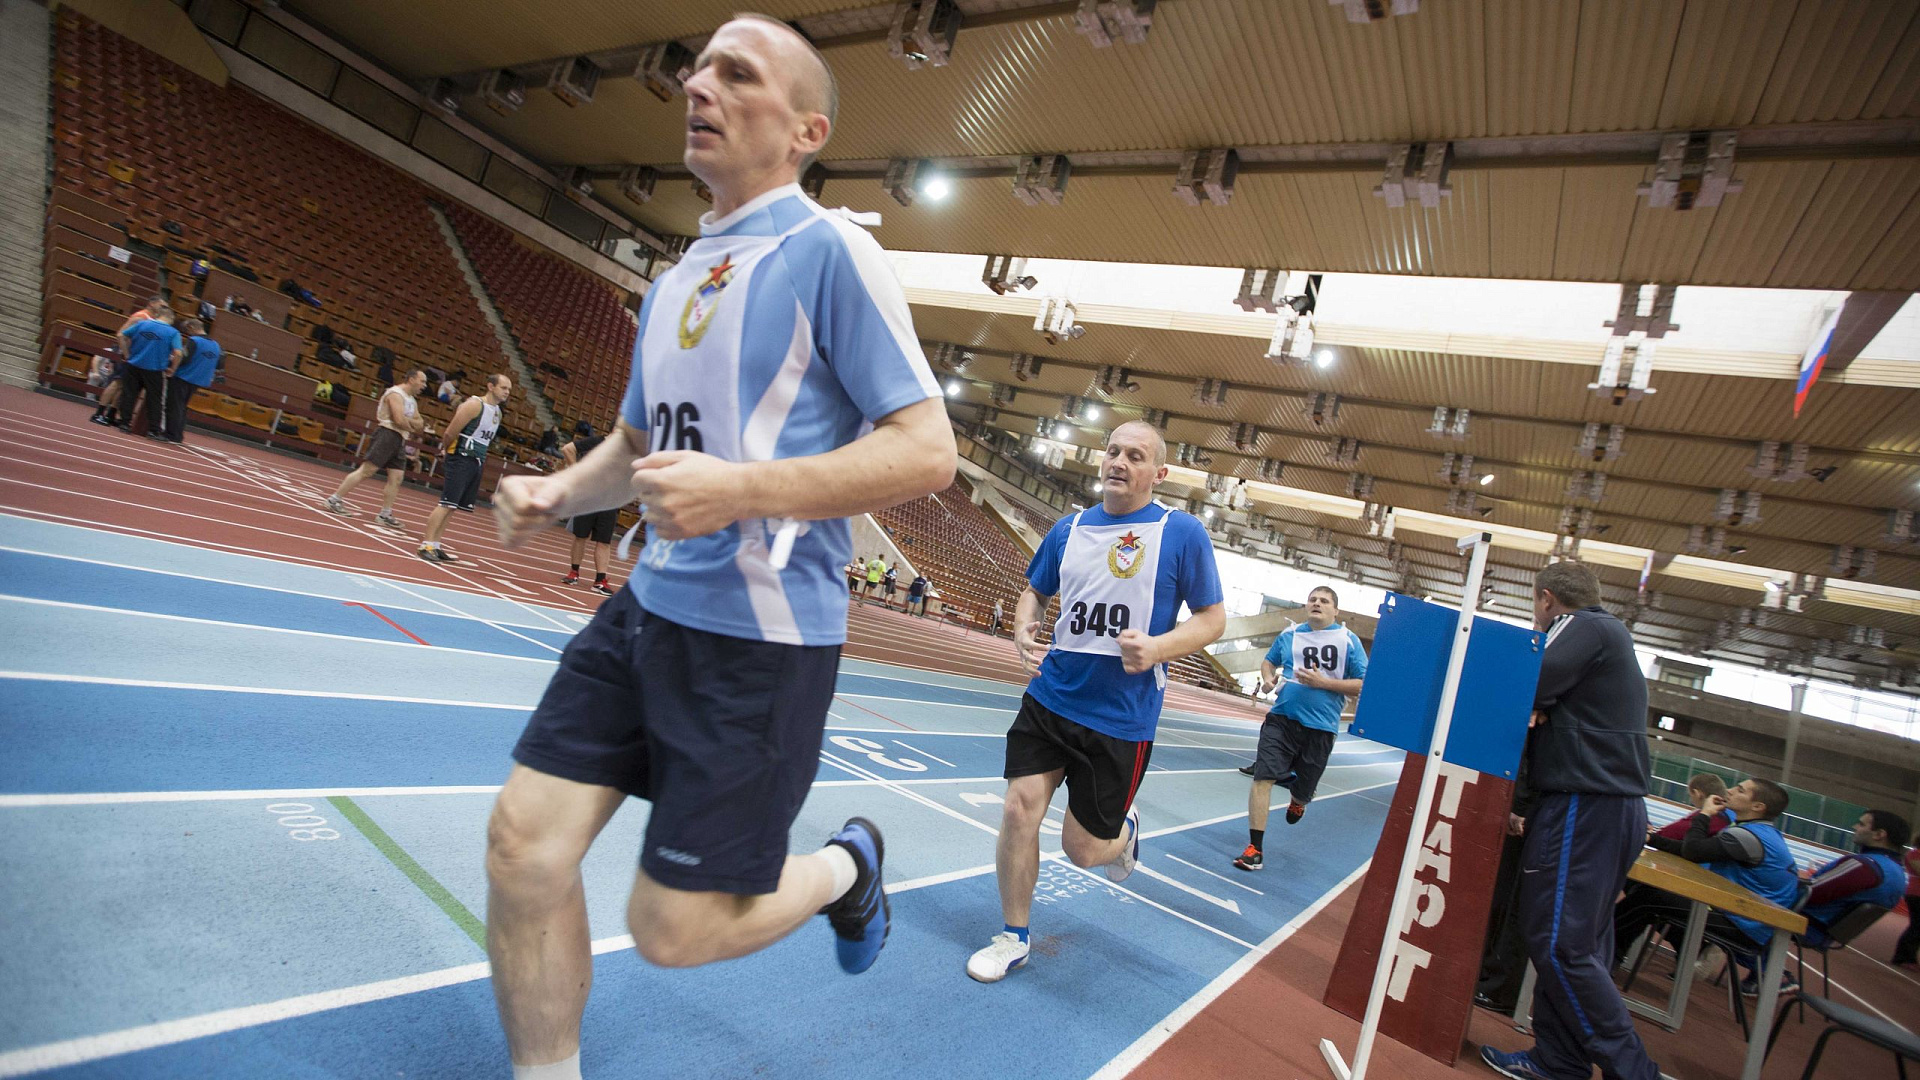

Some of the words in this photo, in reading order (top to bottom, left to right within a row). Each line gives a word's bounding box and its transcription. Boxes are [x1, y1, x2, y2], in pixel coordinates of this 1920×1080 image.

[650, 401, 704, 453] 26
[1070, 601, 1131, 638] 349
[1302, 644, 1338, 671] 89
[829, 735, 928, 772] 3
[265, 802, 340, 842] 800
[1035, 881, 1073, 899] 40
